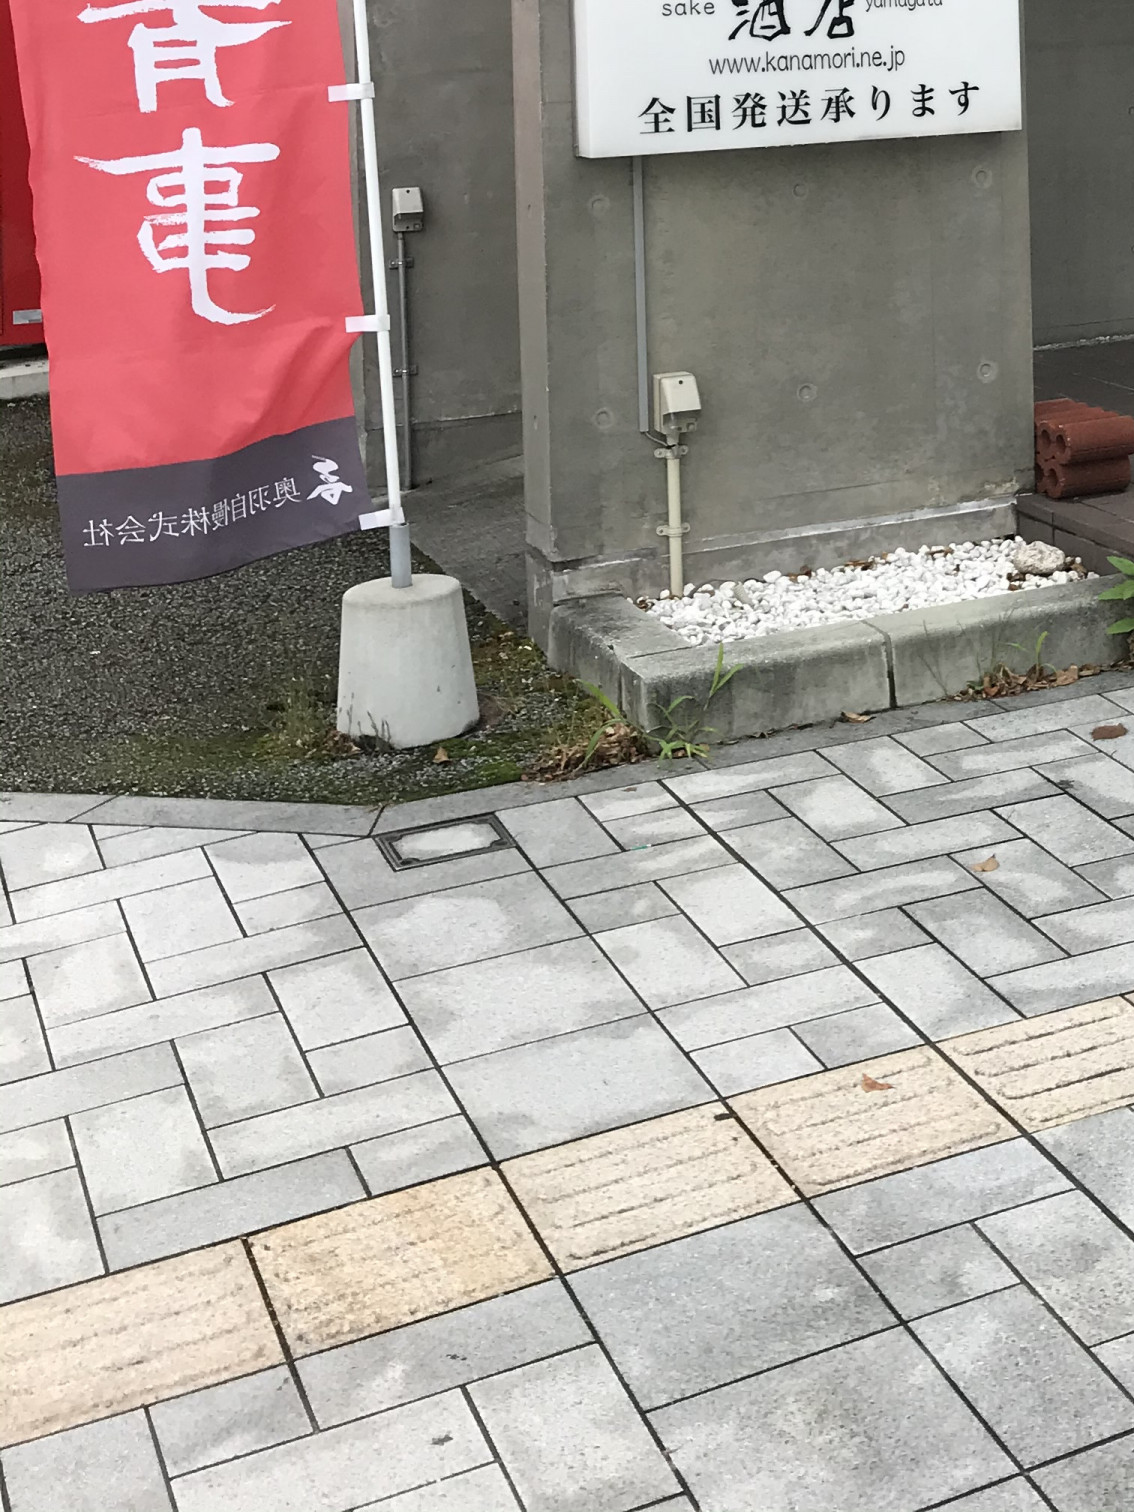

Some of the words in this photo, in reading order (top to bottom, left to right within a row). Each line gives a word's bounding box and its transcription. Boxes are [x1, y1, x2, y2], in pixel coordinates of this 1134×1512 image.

[708, 45, 907, 75] www.kanamori.ne.jp
[638, 80, 980, 136] 全国発送承ります
